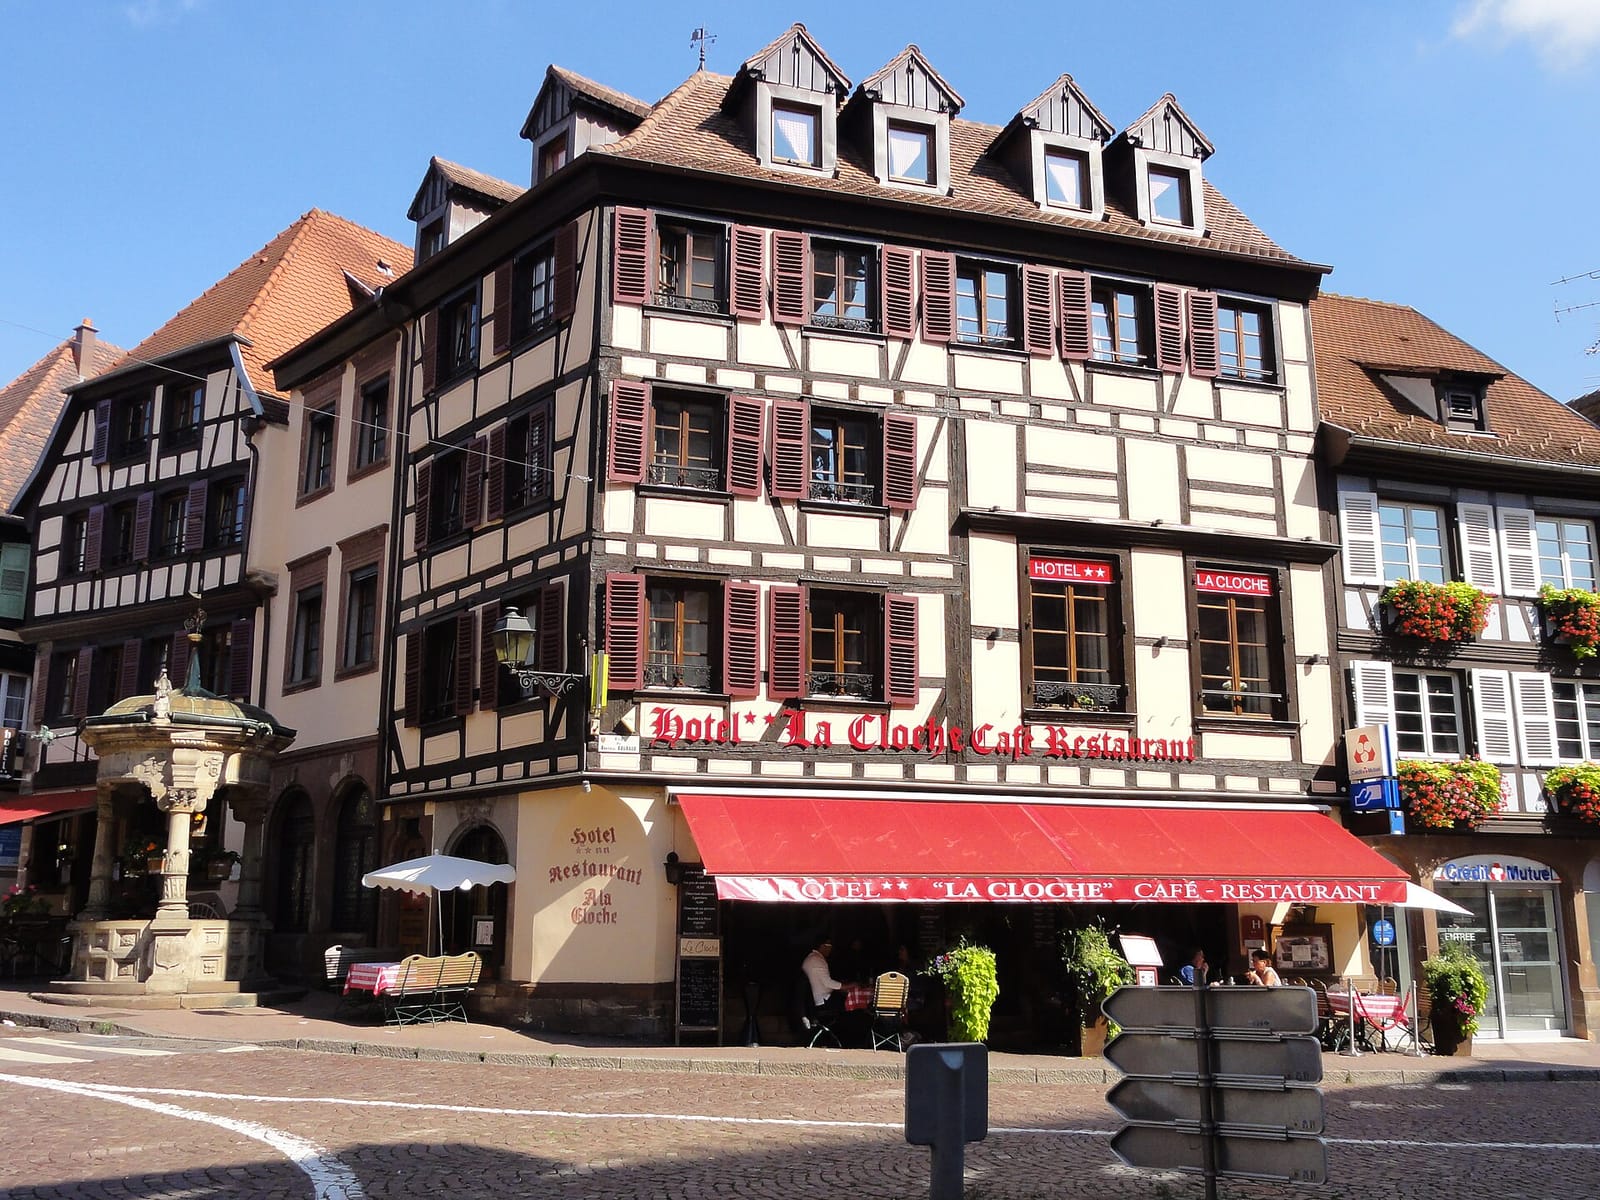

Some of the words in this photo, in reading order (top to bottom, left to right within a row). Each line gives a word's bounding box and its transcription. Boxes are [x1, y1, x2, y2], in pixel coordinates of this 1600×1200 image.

[1034, 561, 1081, 578] HOTEL
[1197, 573, 1215, 587] LA
[1215, 575, 1269, 593] CLOCHE
[650, 706, 741, 748] Hotel
[781, 709, 833, 750] La
[848, 712, 966, 759] Cloche
[1045, 725, 1196, 761] Restaurant
[570, 827, 617, 846] Hotel
[549, 860, 642, 885] Restaurant
[1445, 863, 1489, 881] Crédit
[1506, 865, 1553, 881] Mutuel
[1134, 880, 1200, 899] CAFÉ
[1221, 883, 1382, 901] RESTAURANT
[571, 906, 618, 925] Cloche
